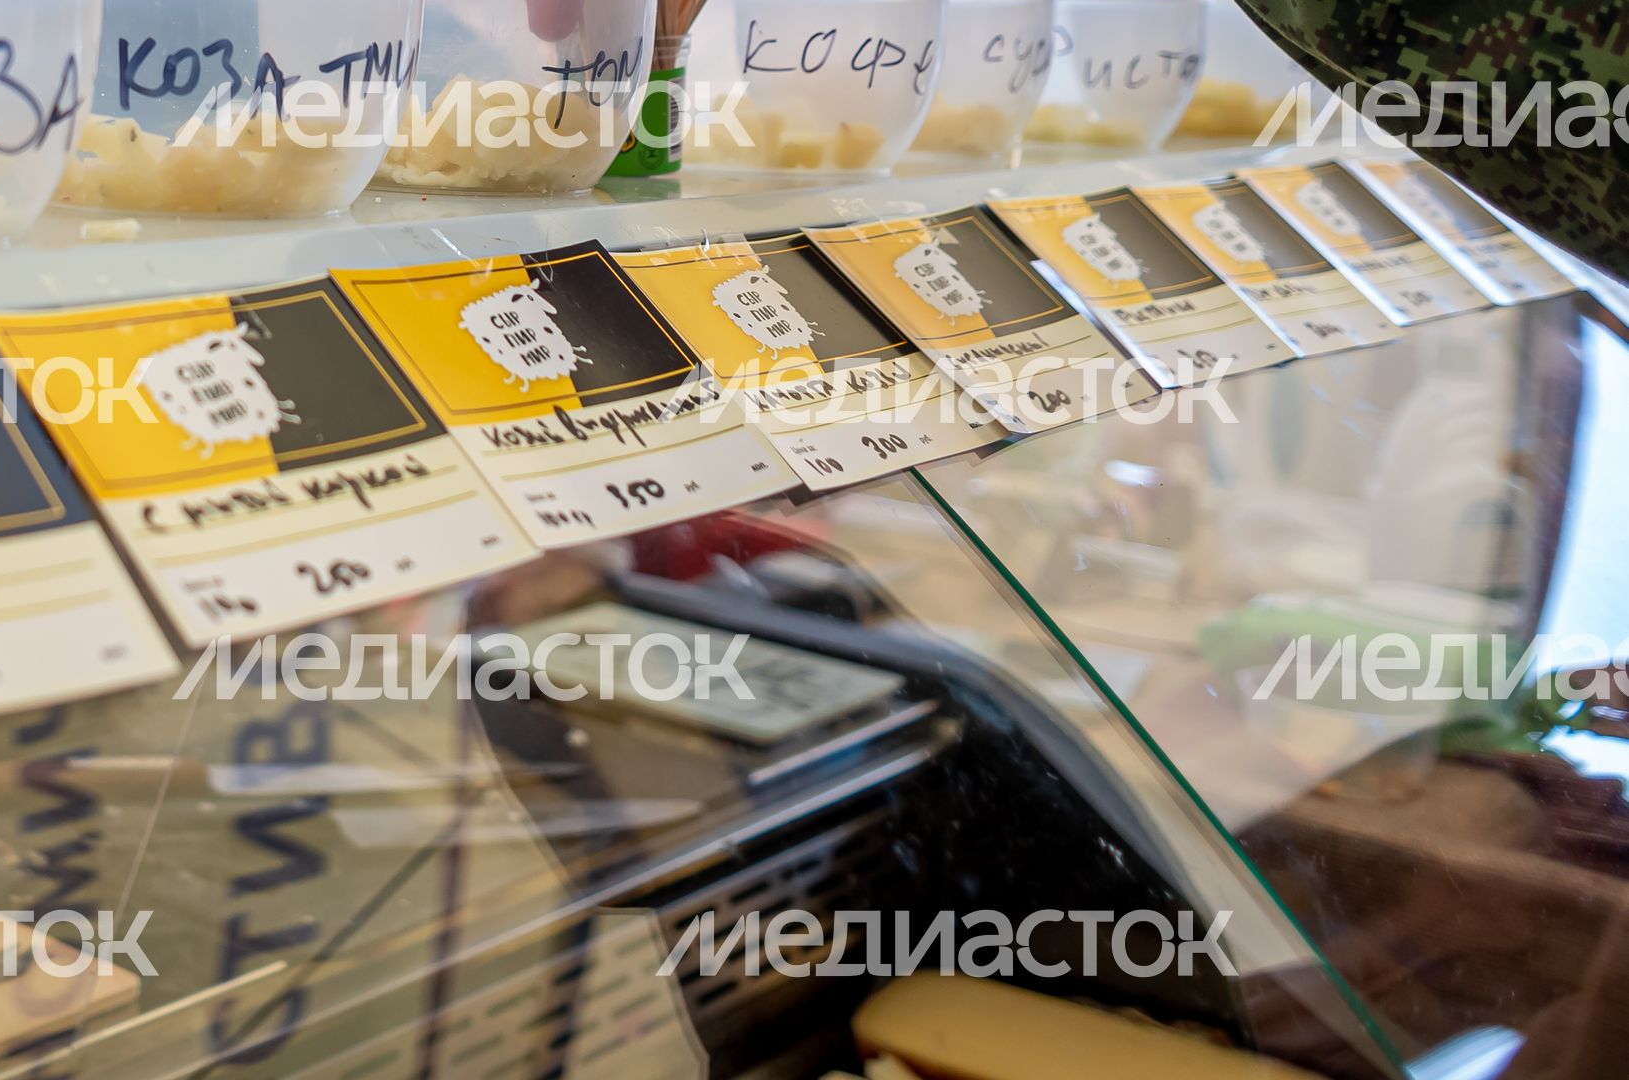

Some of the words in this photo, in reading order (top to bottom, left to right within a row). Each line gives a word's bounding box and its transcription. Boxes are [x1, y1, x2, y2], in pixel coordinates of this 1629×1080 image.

[737, 291, 762, 307] СЫР
[490, 311, 521, 330] СЫР
[750, 305, 779, 322] ПИР
[503, 327, 537, 348] ПИР
[766, 320, 792, 338] МИР
[520, 345, 551, 367] МИР
[1027, 389, 1072, 413] 200
[861, 434, 909, 460] 300
